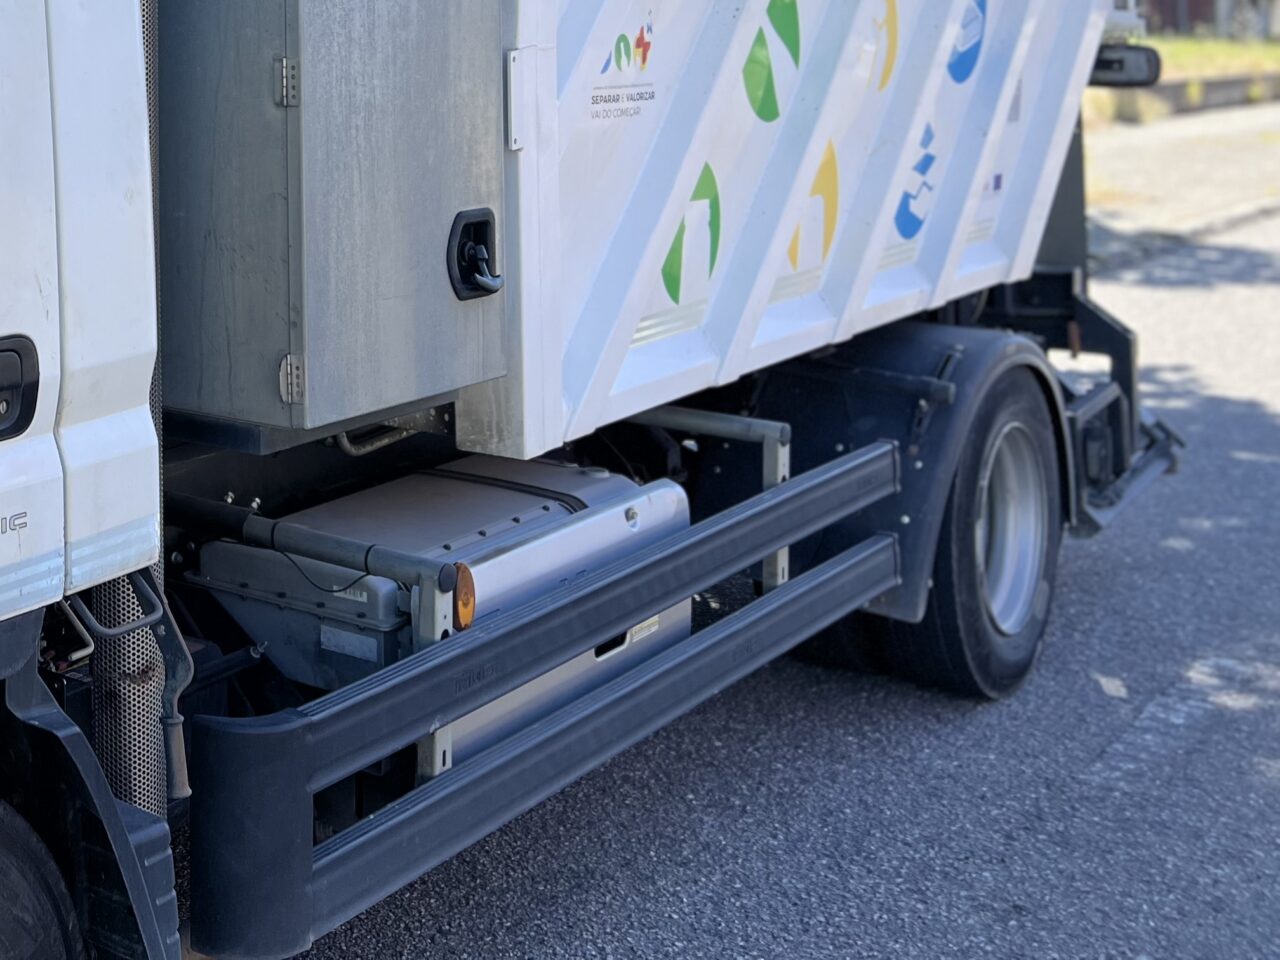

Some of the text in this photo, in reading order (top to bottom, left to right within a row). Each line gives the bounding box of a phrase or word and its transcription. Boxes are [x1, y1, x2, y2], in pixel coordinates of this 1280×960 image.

[592, 94, 620, 104] SEPARAR
[626, 91, 655, 101] VALORIZAR
[603, 109, 611, 119] DO
